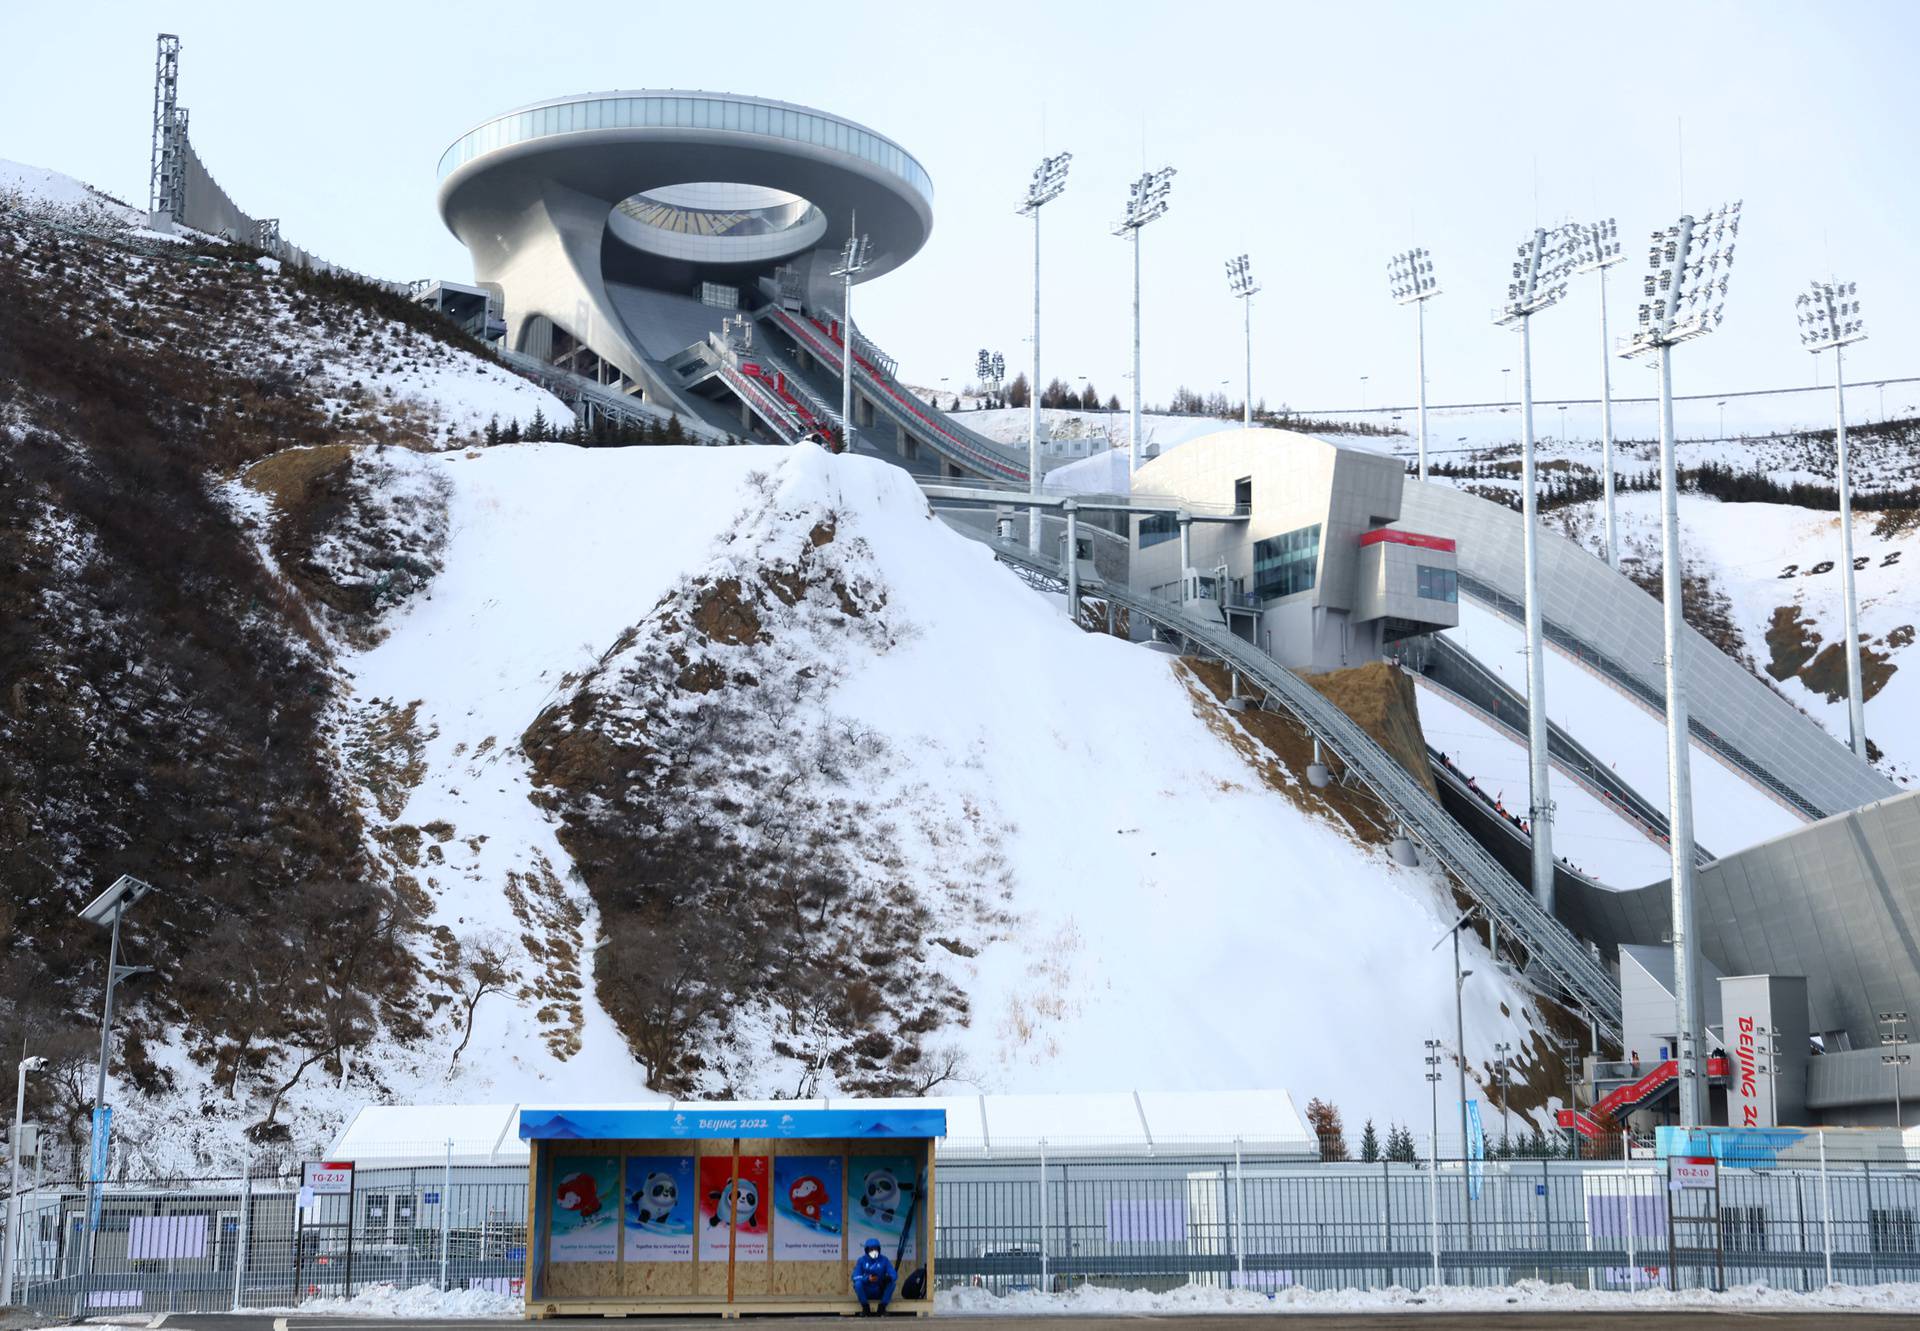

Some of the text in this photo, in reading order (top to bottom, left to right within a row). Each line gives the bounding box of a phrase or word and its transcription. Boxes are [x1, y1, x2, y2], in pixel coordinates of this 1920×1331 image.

[1736, 1016, 1757, 1098] BEIJING
[698, 1119, 768, 1131] BEIJING 2022
